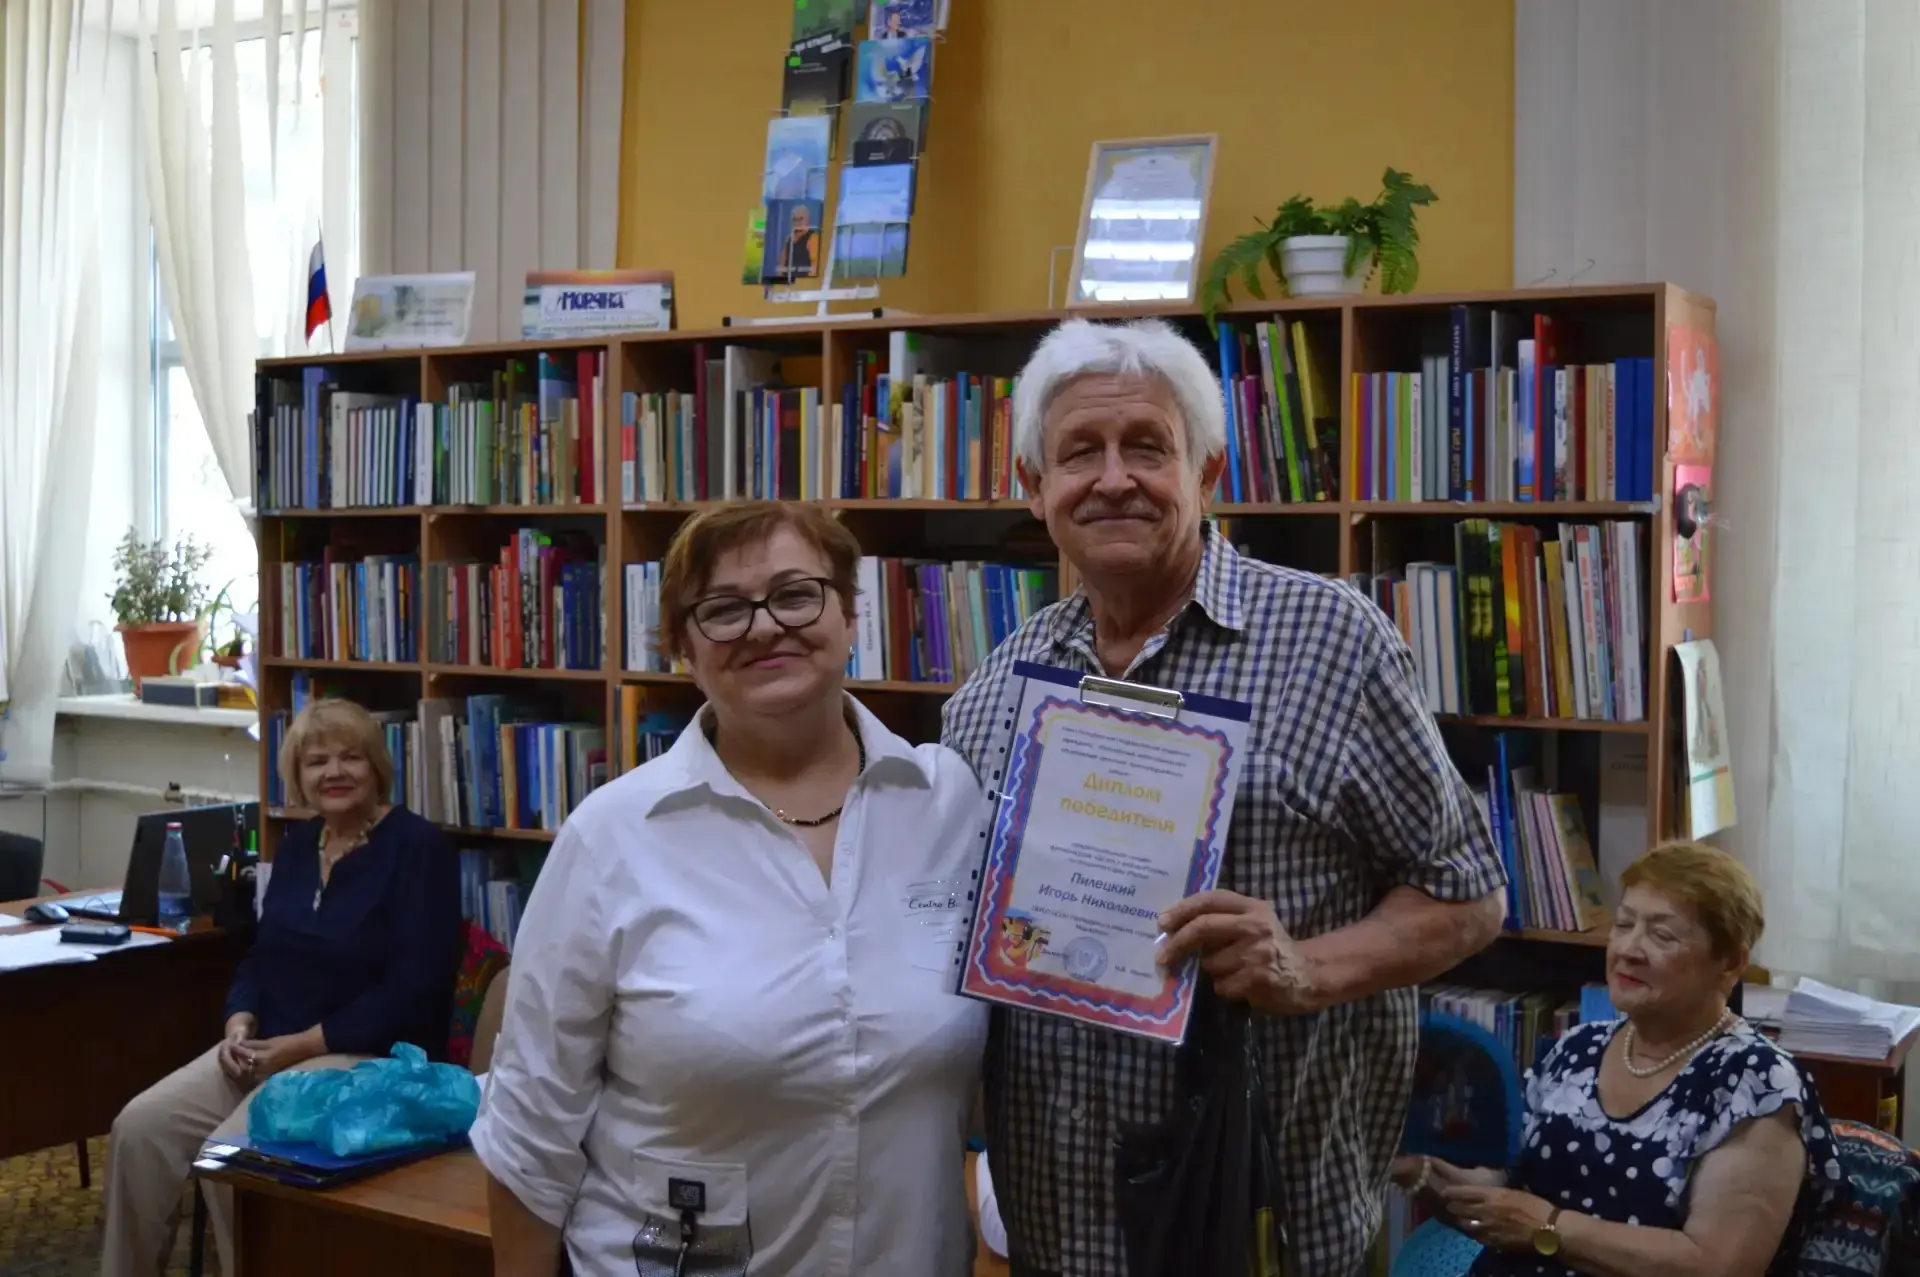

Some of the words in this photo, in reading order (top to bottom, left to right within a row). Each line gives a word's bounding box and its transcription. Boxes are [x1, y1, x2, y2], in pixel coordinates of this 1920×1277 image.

[1083, 771, 1162, 804] Диплом
[1060, 796, 1176, 833] победителя
[1038, 883, 1079, 902] Игорь
[1070, 872, 1137, 897] Пилецкий
